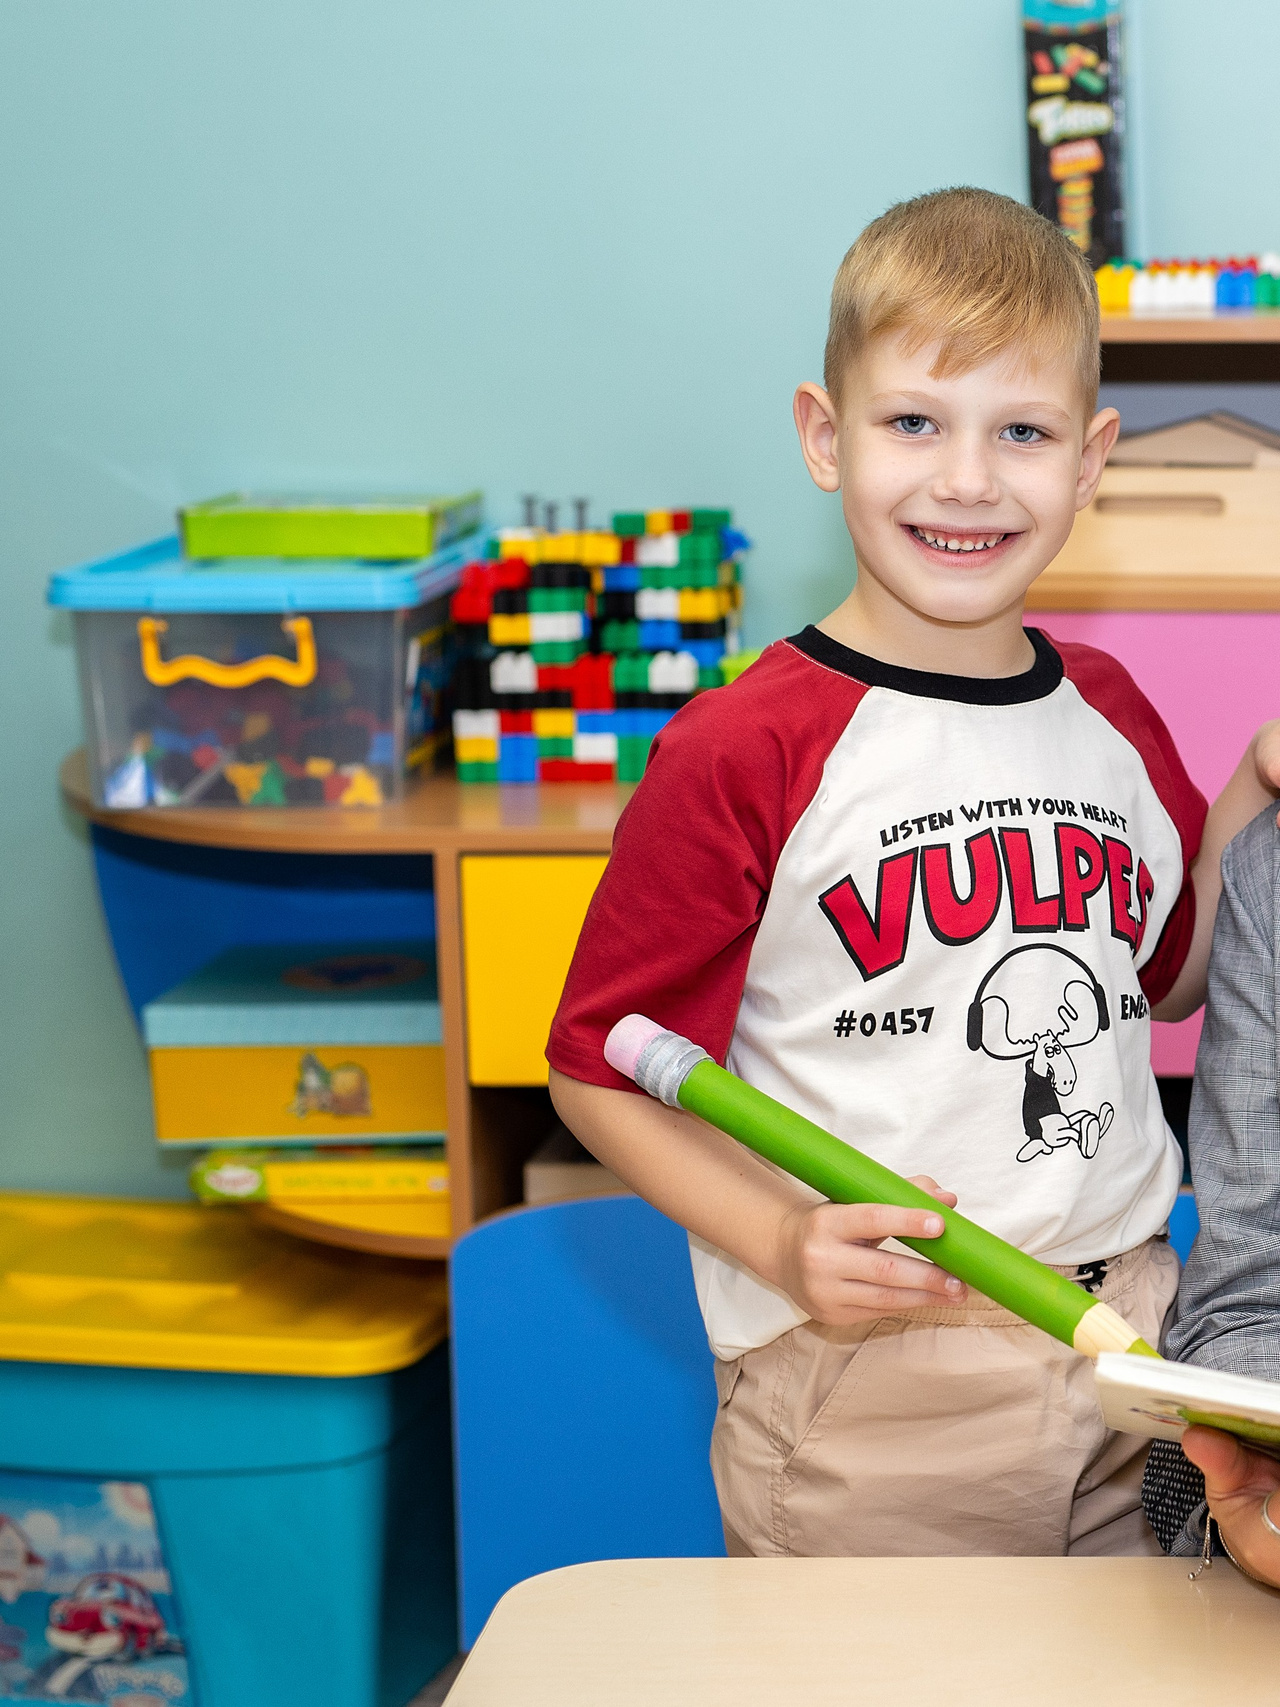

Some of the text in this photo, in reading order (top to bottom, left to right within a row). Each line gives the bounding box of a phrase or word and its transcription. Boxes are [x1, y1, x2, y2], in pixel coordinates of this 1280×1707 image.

[880, 798, 1127, 847] LISTEN WITH YOUR HEART
[833, 1006, 935, 1038] #0457
